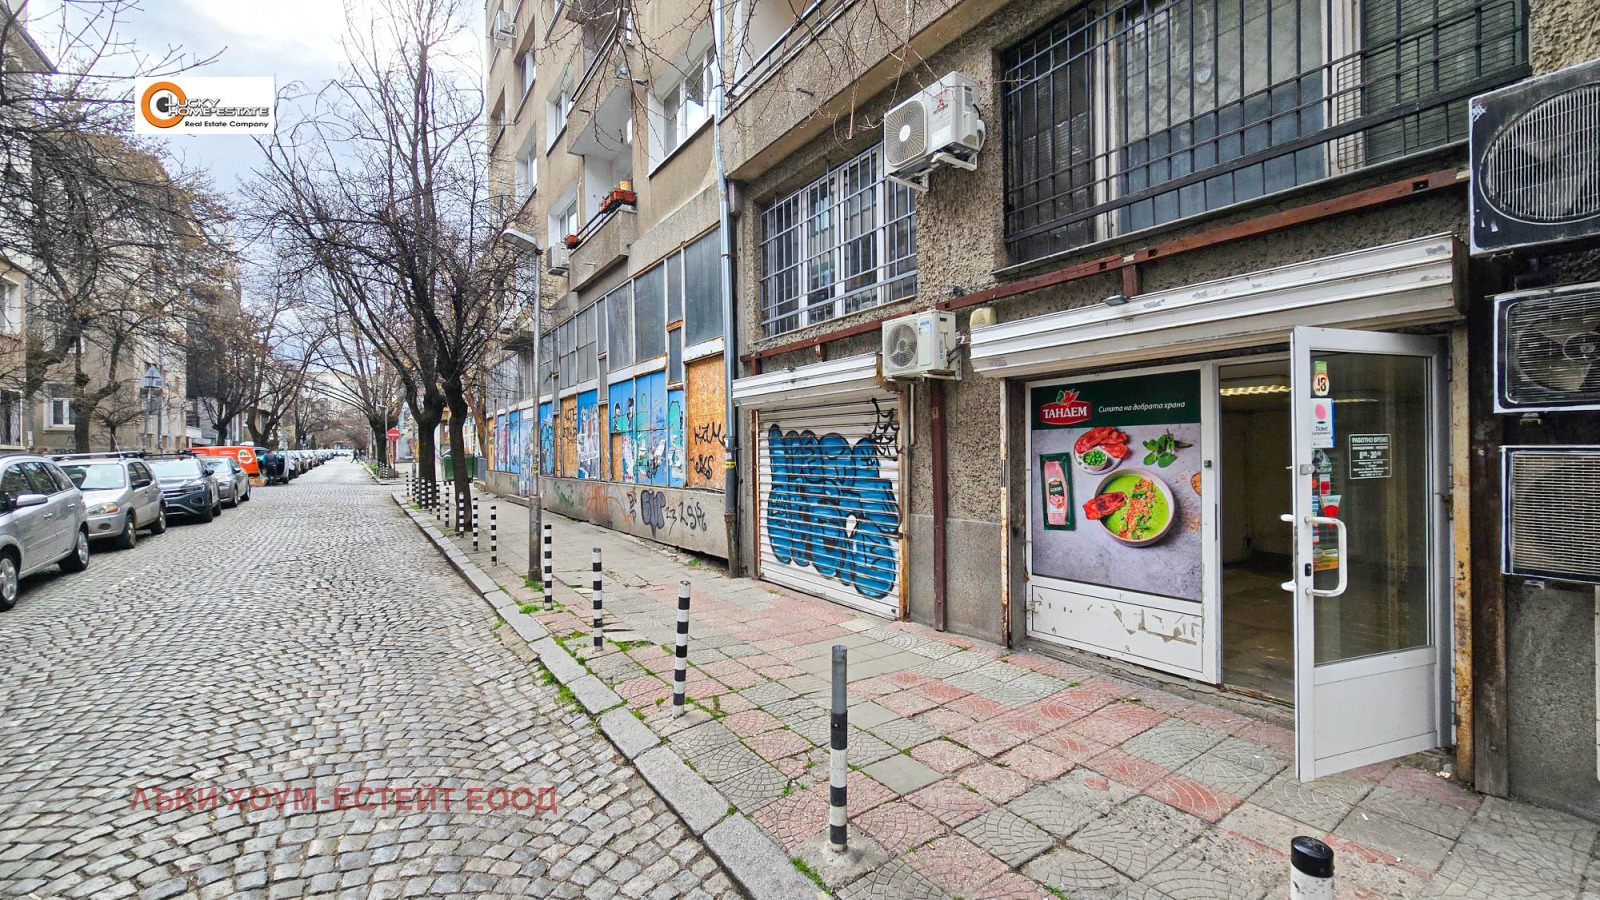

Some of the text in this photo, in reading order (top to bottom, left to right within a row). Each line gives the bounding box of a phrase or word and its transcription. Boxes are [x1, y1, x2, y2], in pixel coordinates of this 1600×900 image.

[1042, 406, 1087, 419] ТАНДЕМ
[1098, 405, 1123, 413] Силата
[1132, 402, 1163, 412] добрата
[1163, 401, 1186, 410] храна
